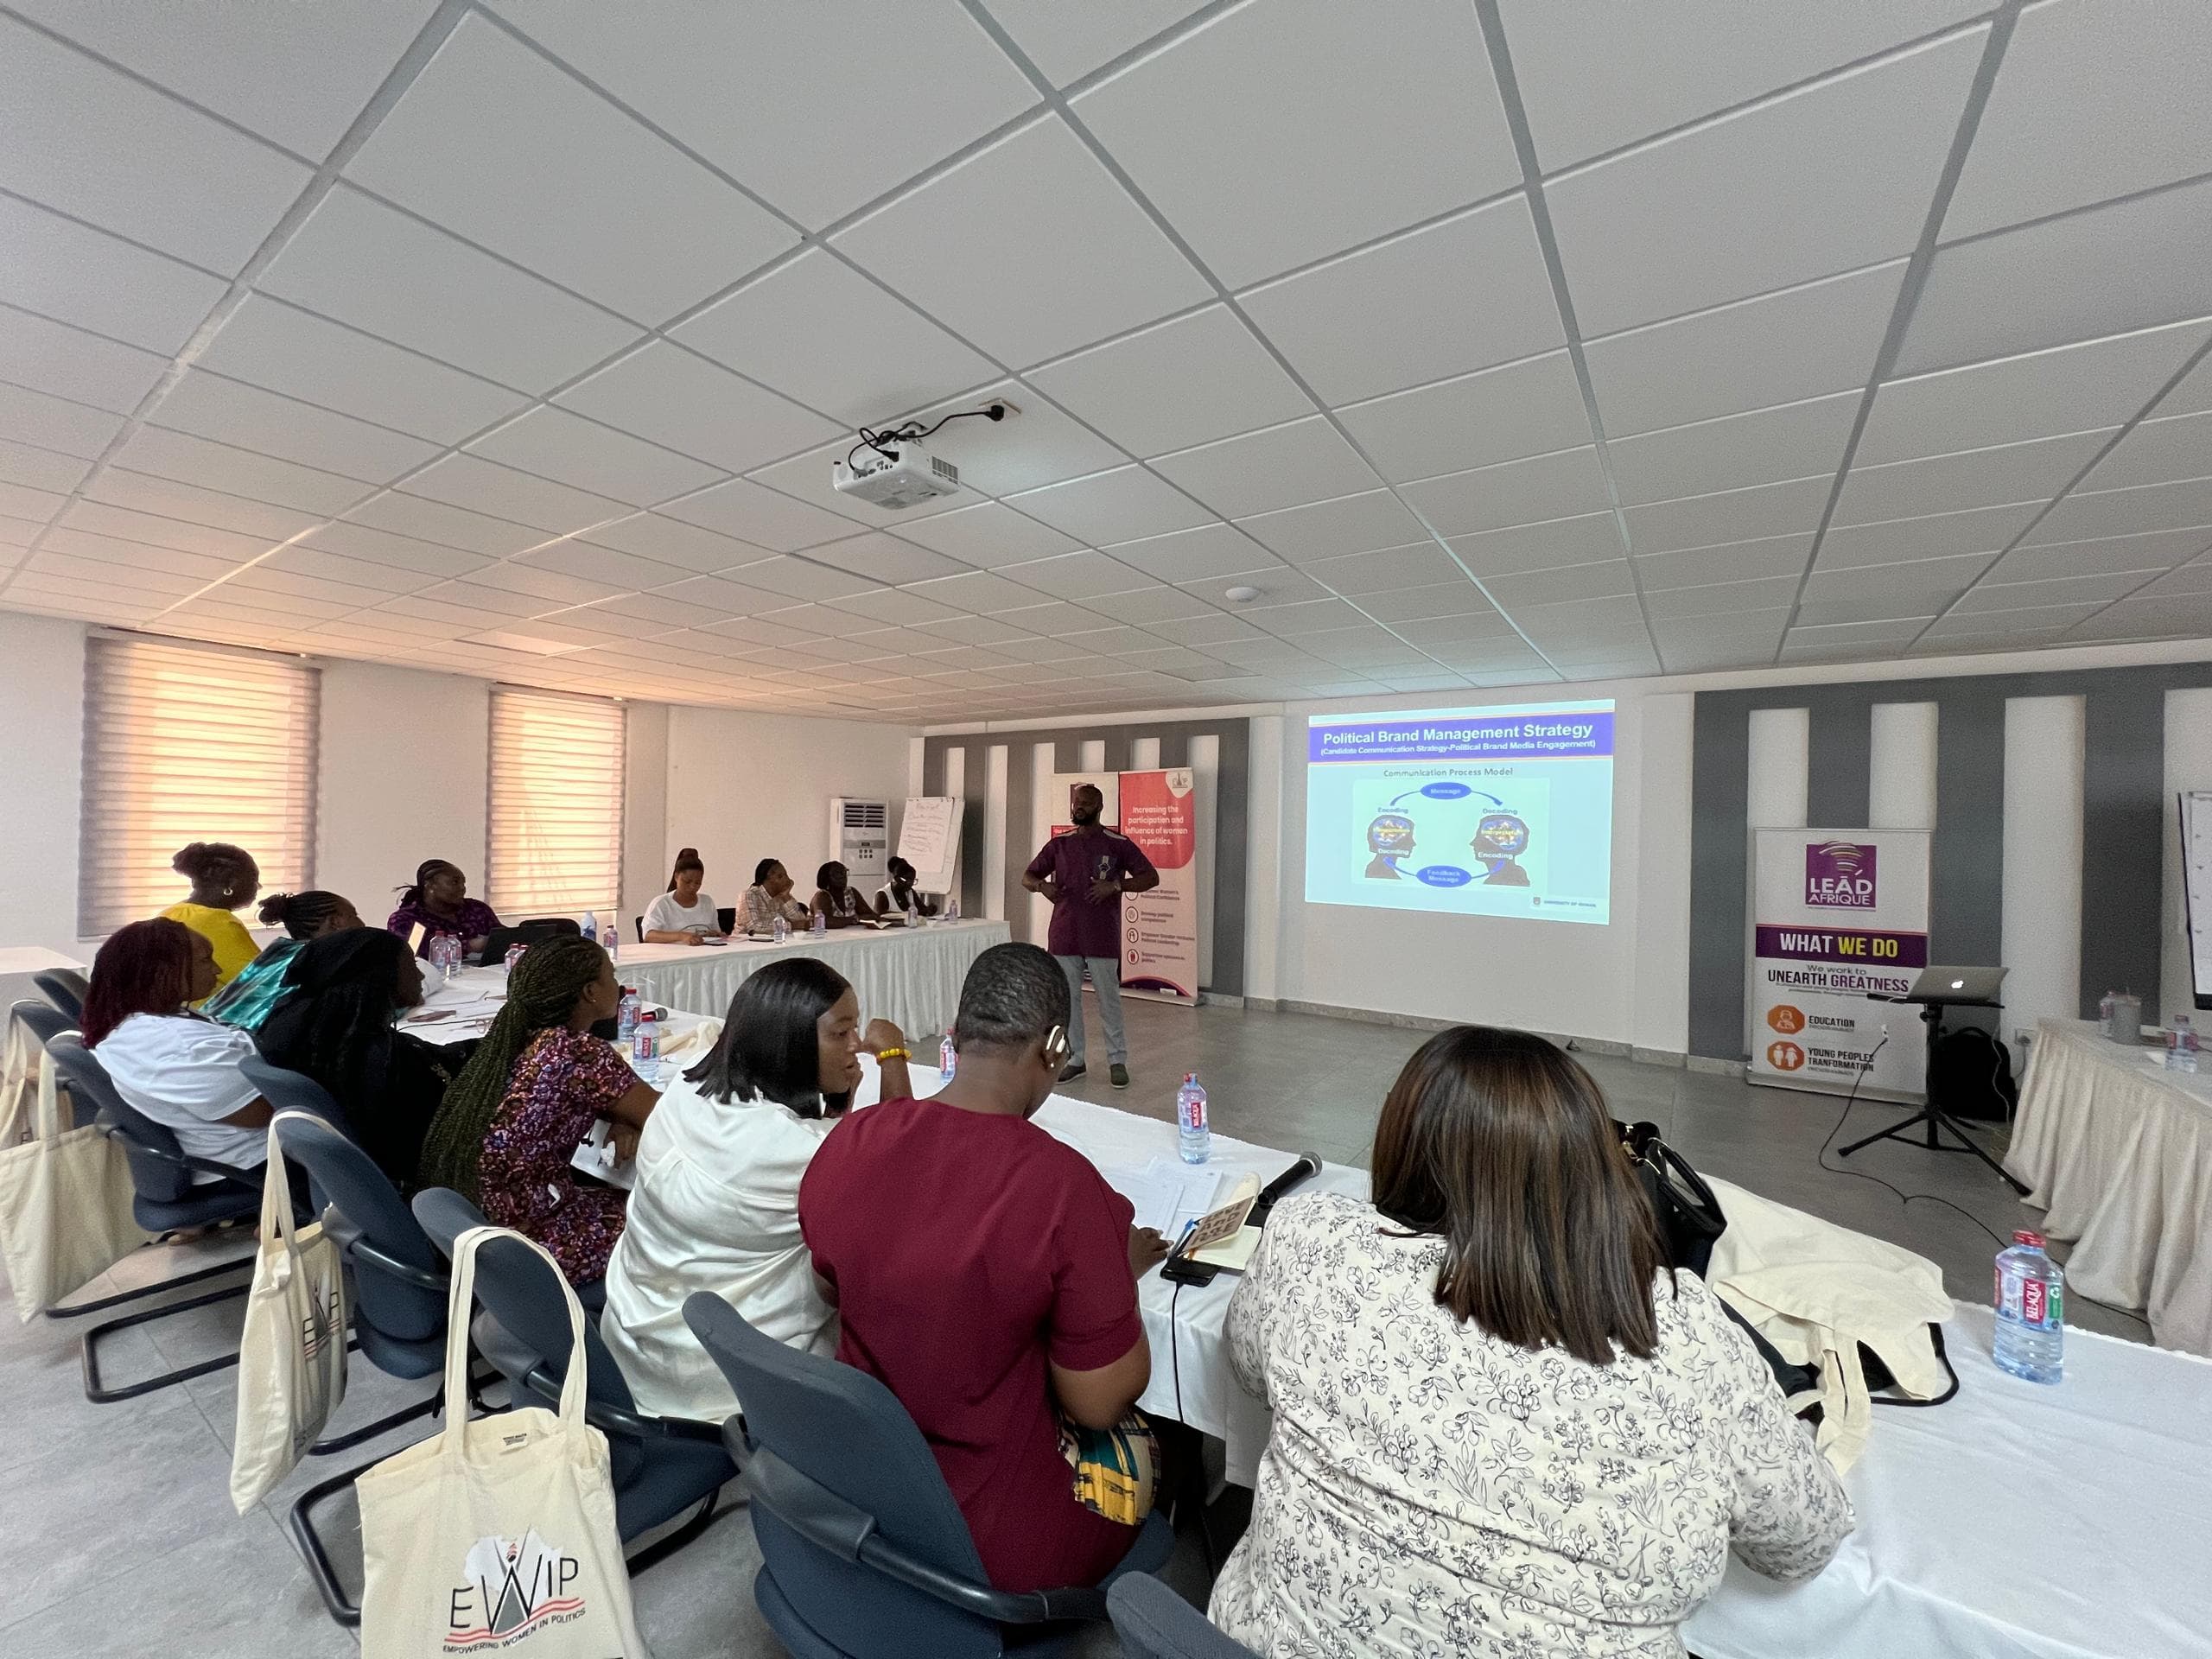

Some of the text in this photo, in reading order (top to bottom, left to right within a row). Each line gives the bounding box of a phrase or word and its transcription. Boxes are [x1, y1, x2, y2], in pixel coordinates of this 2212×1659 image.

[1324, 723, 1593, 745] Political Brand Management Strategy
[1358, 745, 1415, 754] Communication
[1510, 741, 1535, 750] Media
[1537, 740, 1596, 750] Engagement)
[1383, 768, 1446, 778] Communication
[1484, 767, 1513, 776] Model
[1133, 805, 1166, 816] Increasing
[1128, 817, 1170, 827] participation
[1125, 825, 1154, 835] influence
[1155, 826, 1162, 835] of
[1478, 851, 1514, 860] Encoding
[1808, 893, 1871, 905] AFRIQUE
[1780, 933, 1898, 958] WHAT WE DO
[1807, 964, 1824, 973] We
[1827, 966, 1853, 975] work
[1768, 969, 1827, 986] UNEARTH
[1831, 975, 1909, 993] GREATNESS
[1808, 1015, 1855, 1027] EDUCATION
[1808, 1047, 1874, 1063] YOUNG PEOPLES
[1808, 1057, 1874, 1071] TRANFORMATION
[450, 1553, 579, 1636] EWIP
[442, 1608, 587, 1655] EMPOWERING WOMEN IN POLITICS
